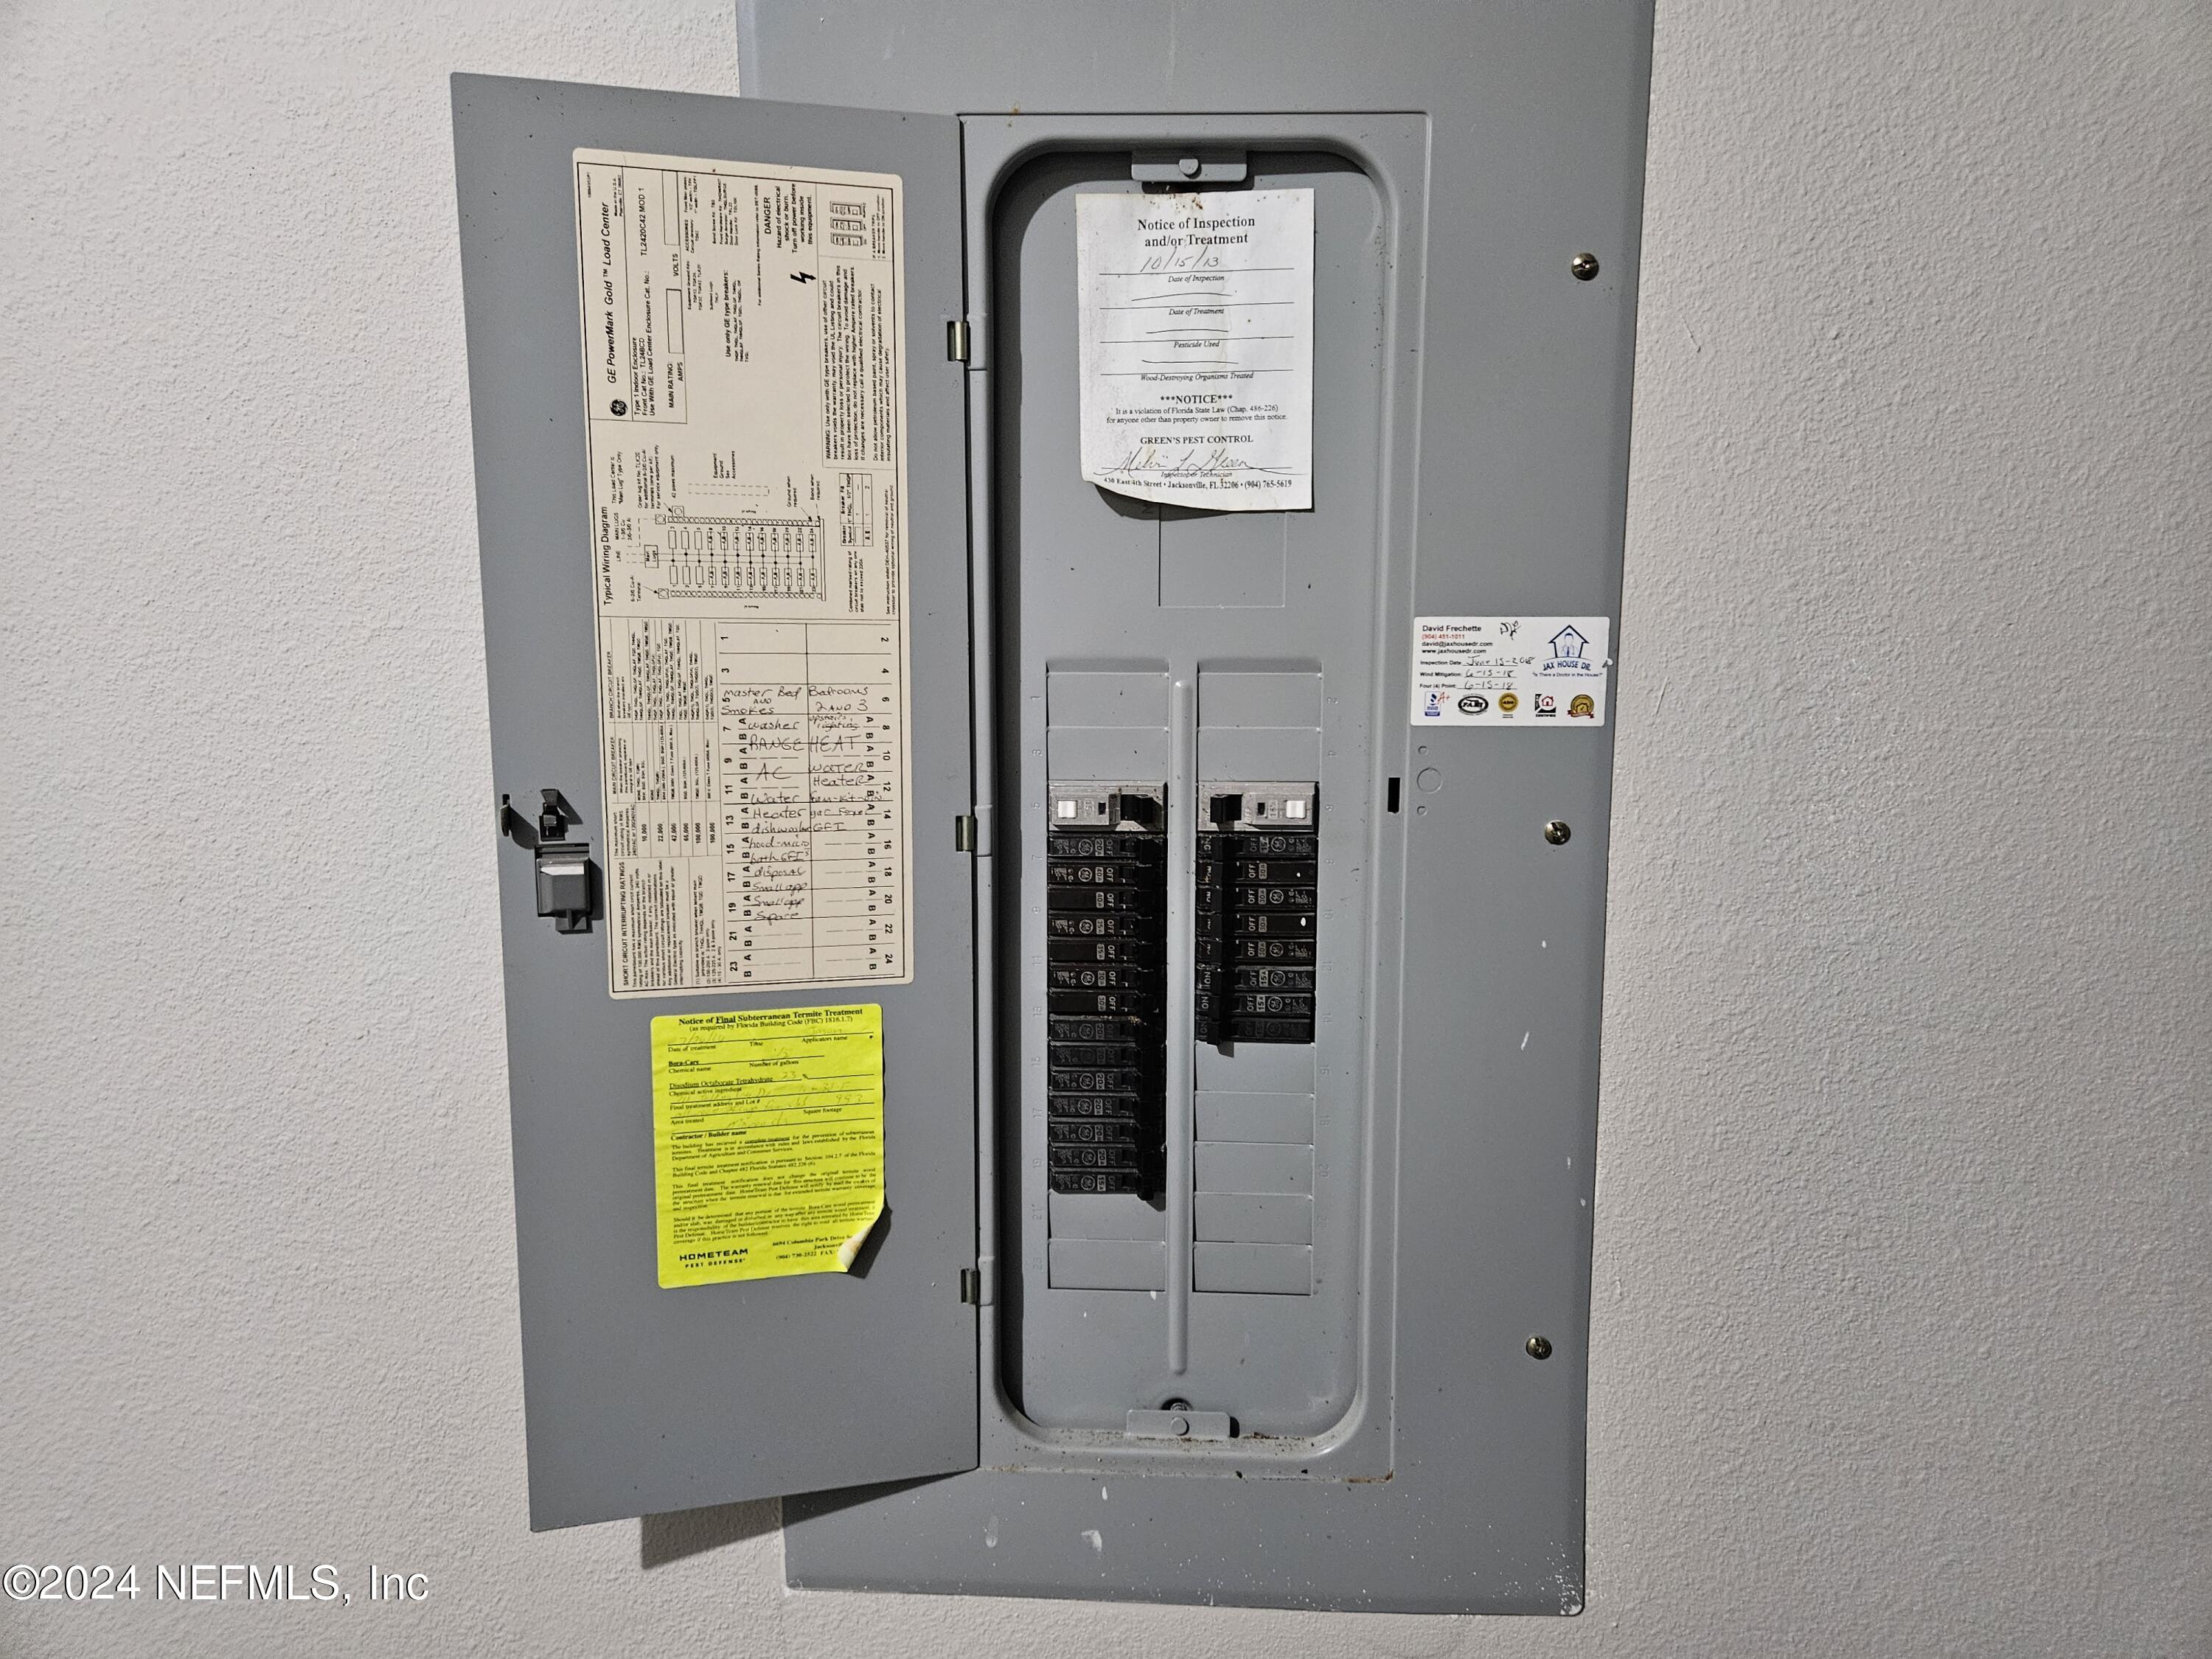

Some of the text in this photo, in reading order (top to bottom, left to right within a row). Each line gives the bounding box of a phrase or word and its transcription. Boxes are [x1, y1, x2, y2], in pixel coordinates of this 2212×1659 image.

[1138, 216, 1255, 231] Notice of Inspection
[1145, 234, 1248, 247] and/or Treatment
[1141, 246, 1218, 272] 10/15/13
[599, 202, 616, 383] GE PowerMark Gold Load Center
[725, 319, 730, 327] GE
[633, 400, 641, 415] Type
[1228, 406, 1248, 414] (Chap.
[1141, 436, 1180, 444] GREEN'S
[1207, 435, 1253, 443] CONTROL
[1168, 480, 1208, 490] Jacksonville,
[1245, 480, 1261, 489] (904)
[1263, 480, 1292, 488] 765-5619
[600, 507, 613, 605] Typical Wiring Diagram
[1543, 661, 1554, 671] JAX
[749, 734, 804, 751] RANGE
[810, 735, 861, 753] HEAT
[883, 751, 890, 760] 10
[756, 762, 791, 781] AC
[725, 785, 733, 794] 11
[883, 782, 891, 791] 12
[883, 810, 891, 819] 14
[726, 815, 734, 825] 13
[726, 844, 734, 854] 15
[884, 840, 891, 849] 16
[885, 867, 891, 876] 18
[728, 872, 735, 882] 17
[885, 894, 892, 904] 20
[728, 902, 737, 913] 19
[885, 924, 893, 933] 22
[729, 931, 737, 941] 21
[886, 954, 893, 964] 24
[730, 961, 737, 971] 23
[716, 1015, 735, 1023] Final
[737, 1013, 790, 1021] Subterranean
[700, 1023, 725, 1032] required
[760, 1019, 785, 1027] Building
[679, 1248, 748, 1261] HOMETEAM
